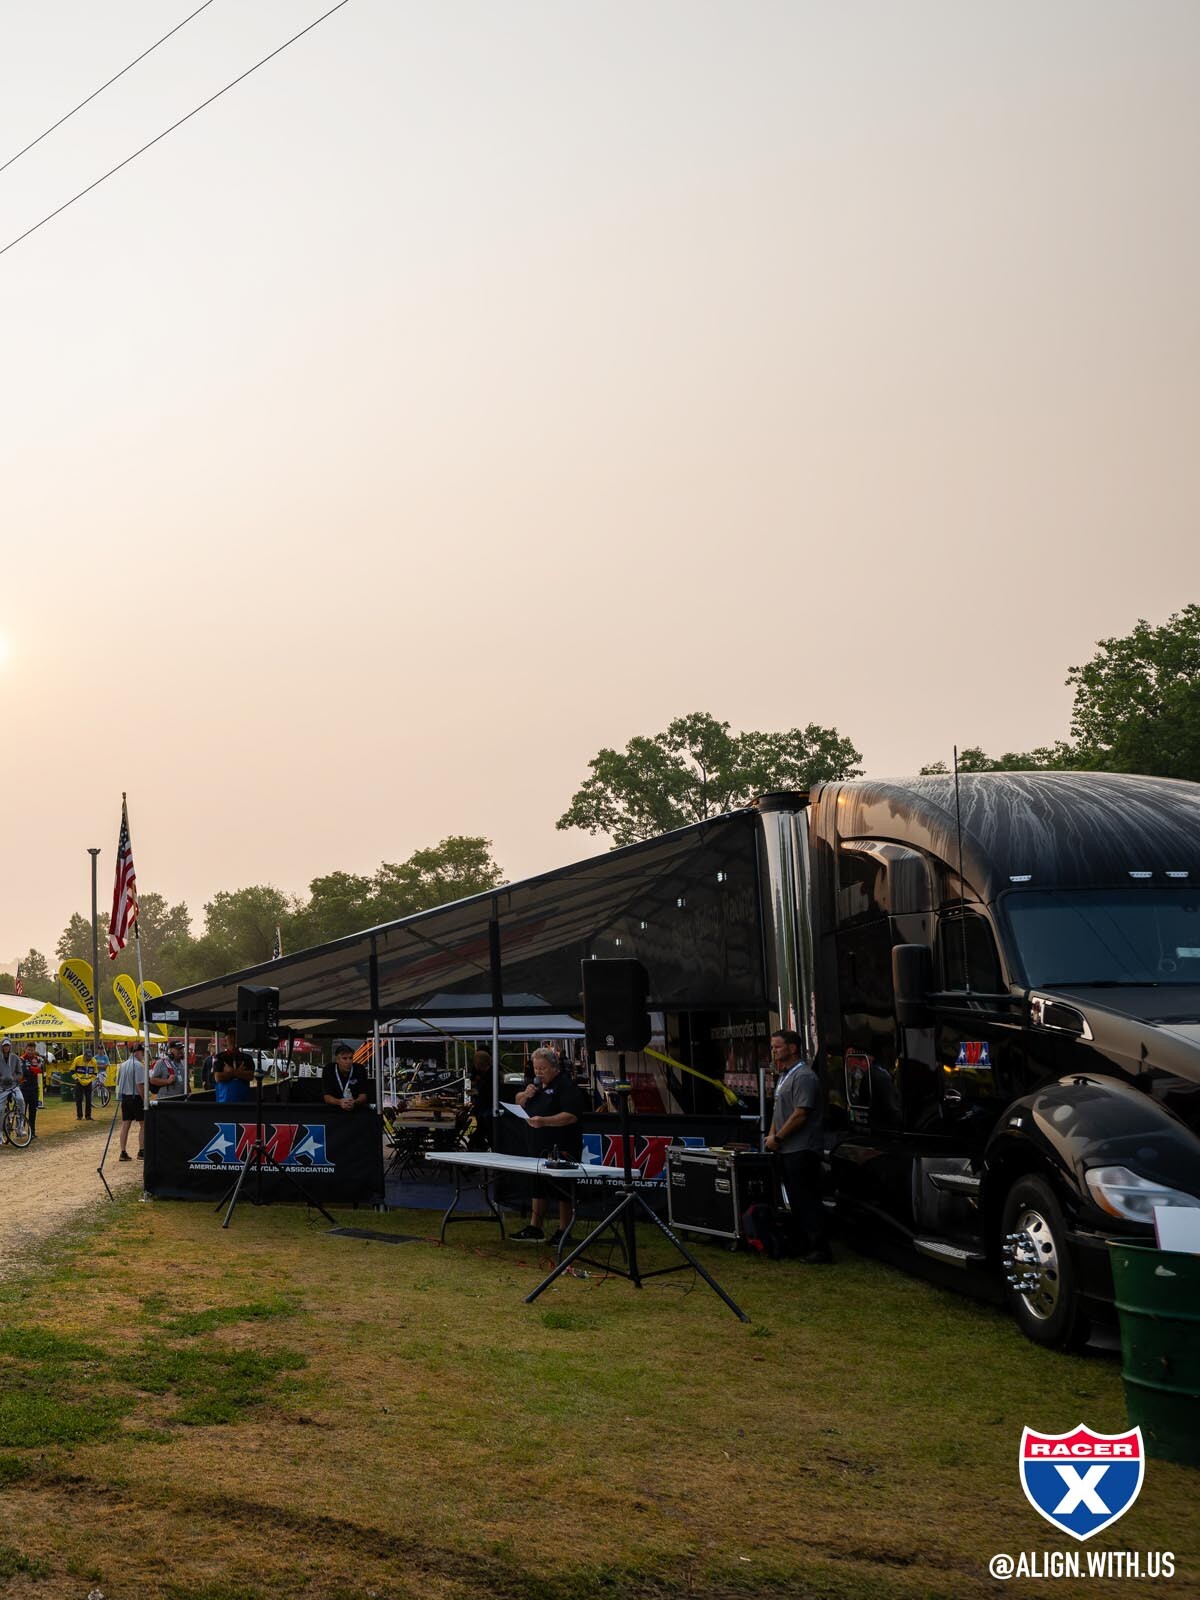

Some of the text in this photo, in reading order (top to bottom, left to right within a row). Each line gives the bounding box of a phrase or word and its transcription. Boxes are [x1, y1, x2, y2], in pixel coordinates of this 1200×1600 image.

[62, 967, 90, 998] TWISTED
[115, 982, 138, 1021] TWISTED TEA
[954, 1041, 992, 1066] AMA
[187, 1122, 337, 1167] AMA
[189, 1163, 228, 1171] AMERICAN
[594, 1178, 659, 1187] MTORYCLIST
